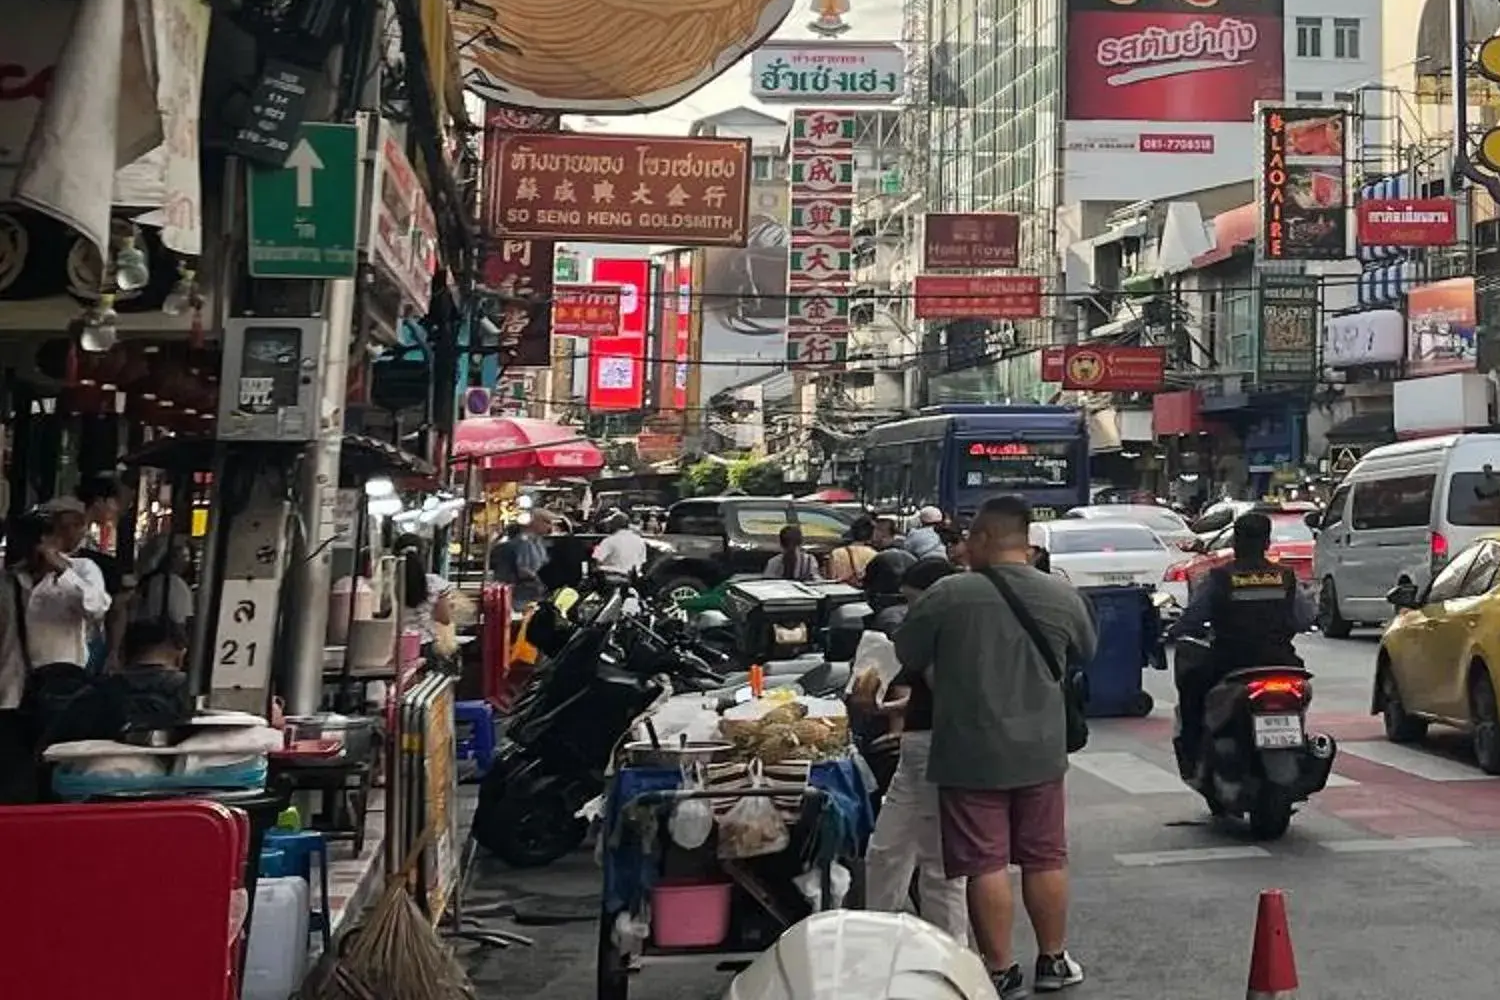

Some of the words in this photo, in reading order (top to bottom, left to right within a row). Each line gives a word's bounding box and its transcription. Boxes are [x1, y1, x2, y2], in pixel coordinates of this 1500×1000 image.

[1098, 18, 1257, 65] รสต้มยำกุ้ง
[511, 146, 624, 173] ห้างขายทอง
[507, 209, 530, 224] SO
[536, 209, 581, 225] SENG
[587, 211, 633, 226] HENG
[639, 213, 734, 229] GOLDSMITH
[801, 114, 840, 363] 和成興大金行
[220, 639, 257, 667] 21
